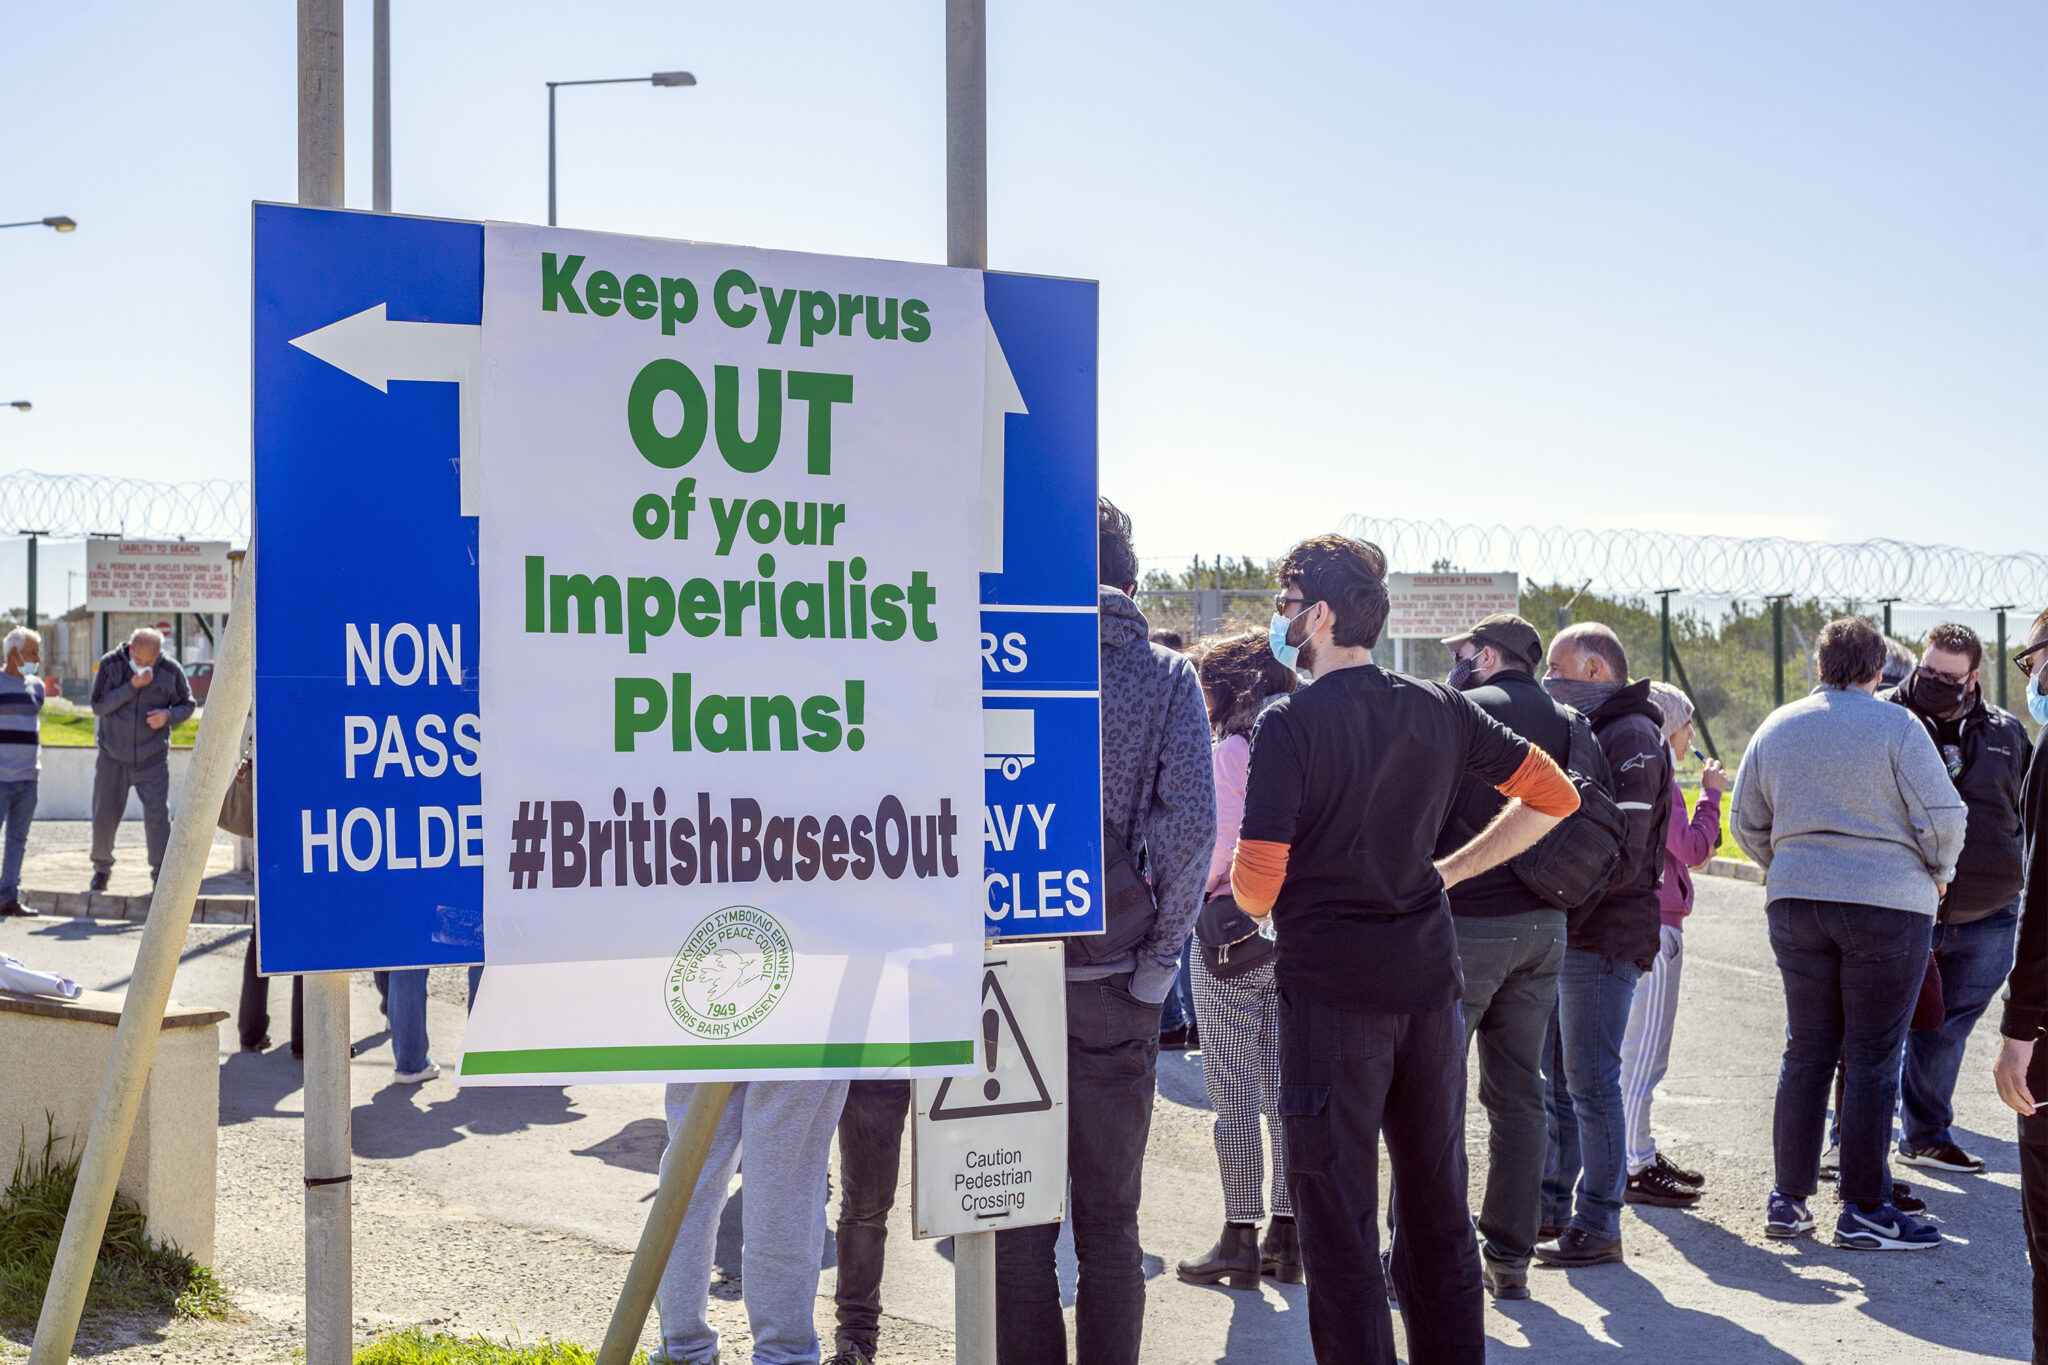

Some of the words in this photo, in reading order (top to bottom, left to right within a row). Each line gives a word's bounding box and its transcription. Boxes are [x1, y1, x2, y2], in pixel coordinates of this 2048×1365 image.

[541, 252, 699, 336] Keep
[713, 268, 932, 347] Cyprus
[627, 358, 854, 475] OUT
[118, 543, 153, 552] LIABILITY
[157, 544, 167, 552] TO
[170, 544, 200, 553] SEARCH
[632, 477, 697, 540] of
[709, 497, 846, 556] your
[525, 552, 939, 654] Imperialist
[346, 622, 462, 686] NON
[614, 673, 866, 753] Plans!
[344, 713, 482, 779] PASS
[508, 786, 959, 889] #BritishBasesOut
[670, 921, 715, 983] ΠΑΓΚΥΠΡΙΟ
[715, 910, 773, 932] ΣΥΜΒΟΥΛΙΟ
[771, 928, 789, 982] ΕΙΡΗΝΗΣ
[685, 938, 717, 982] CYPRUS
[718, 927, 756, 943] PEACE
[755, 934, 774, 982] COUNCIL
[670, 996, 698, 1028] KIBRIS
[696, 1023, 730, 1037] BARIŞ
[707, 1002, 737, 1017] 1949
[954, 1168, 1032, 1191] Pedestrian
[965, 1149, 1022, 1169] Caution
[961, 1190, 1025, 1212] Crossing
